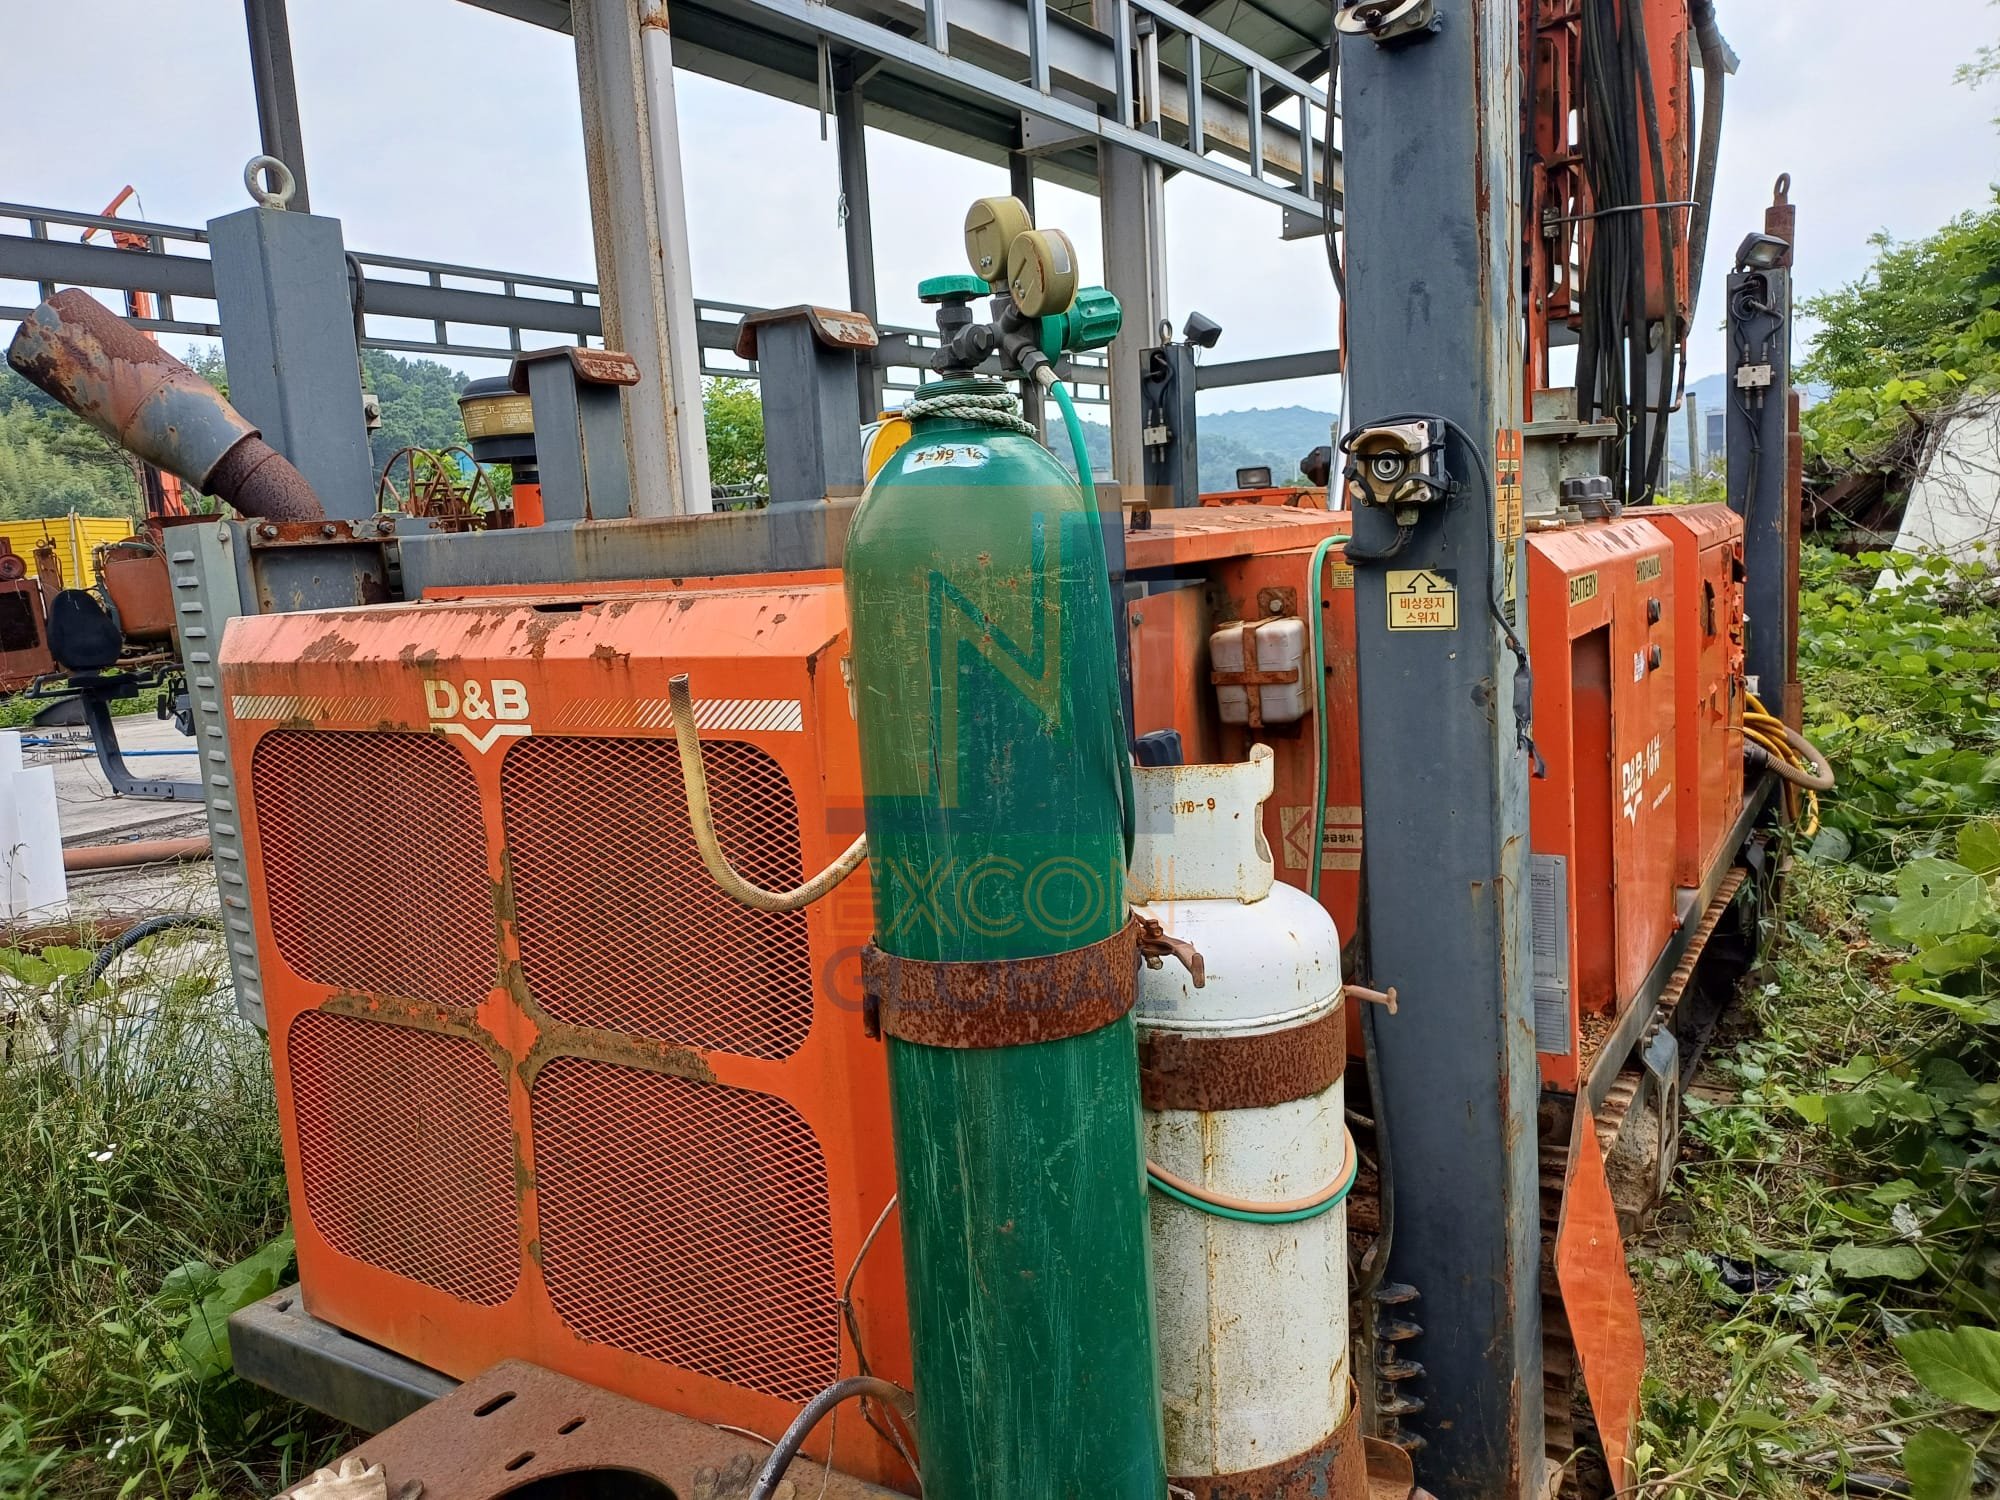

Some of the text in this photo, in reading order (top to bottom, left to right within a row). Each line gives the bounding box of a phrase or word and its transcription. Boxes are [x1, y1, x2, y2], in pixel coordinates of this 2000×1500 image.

[1569, 573, 1597, 604] BATTERY
[1400, 597, 1445, 610] 비상정지
[1406, 612, 1440, 624] 스위치
[424, 680, 530, 720] D&B
